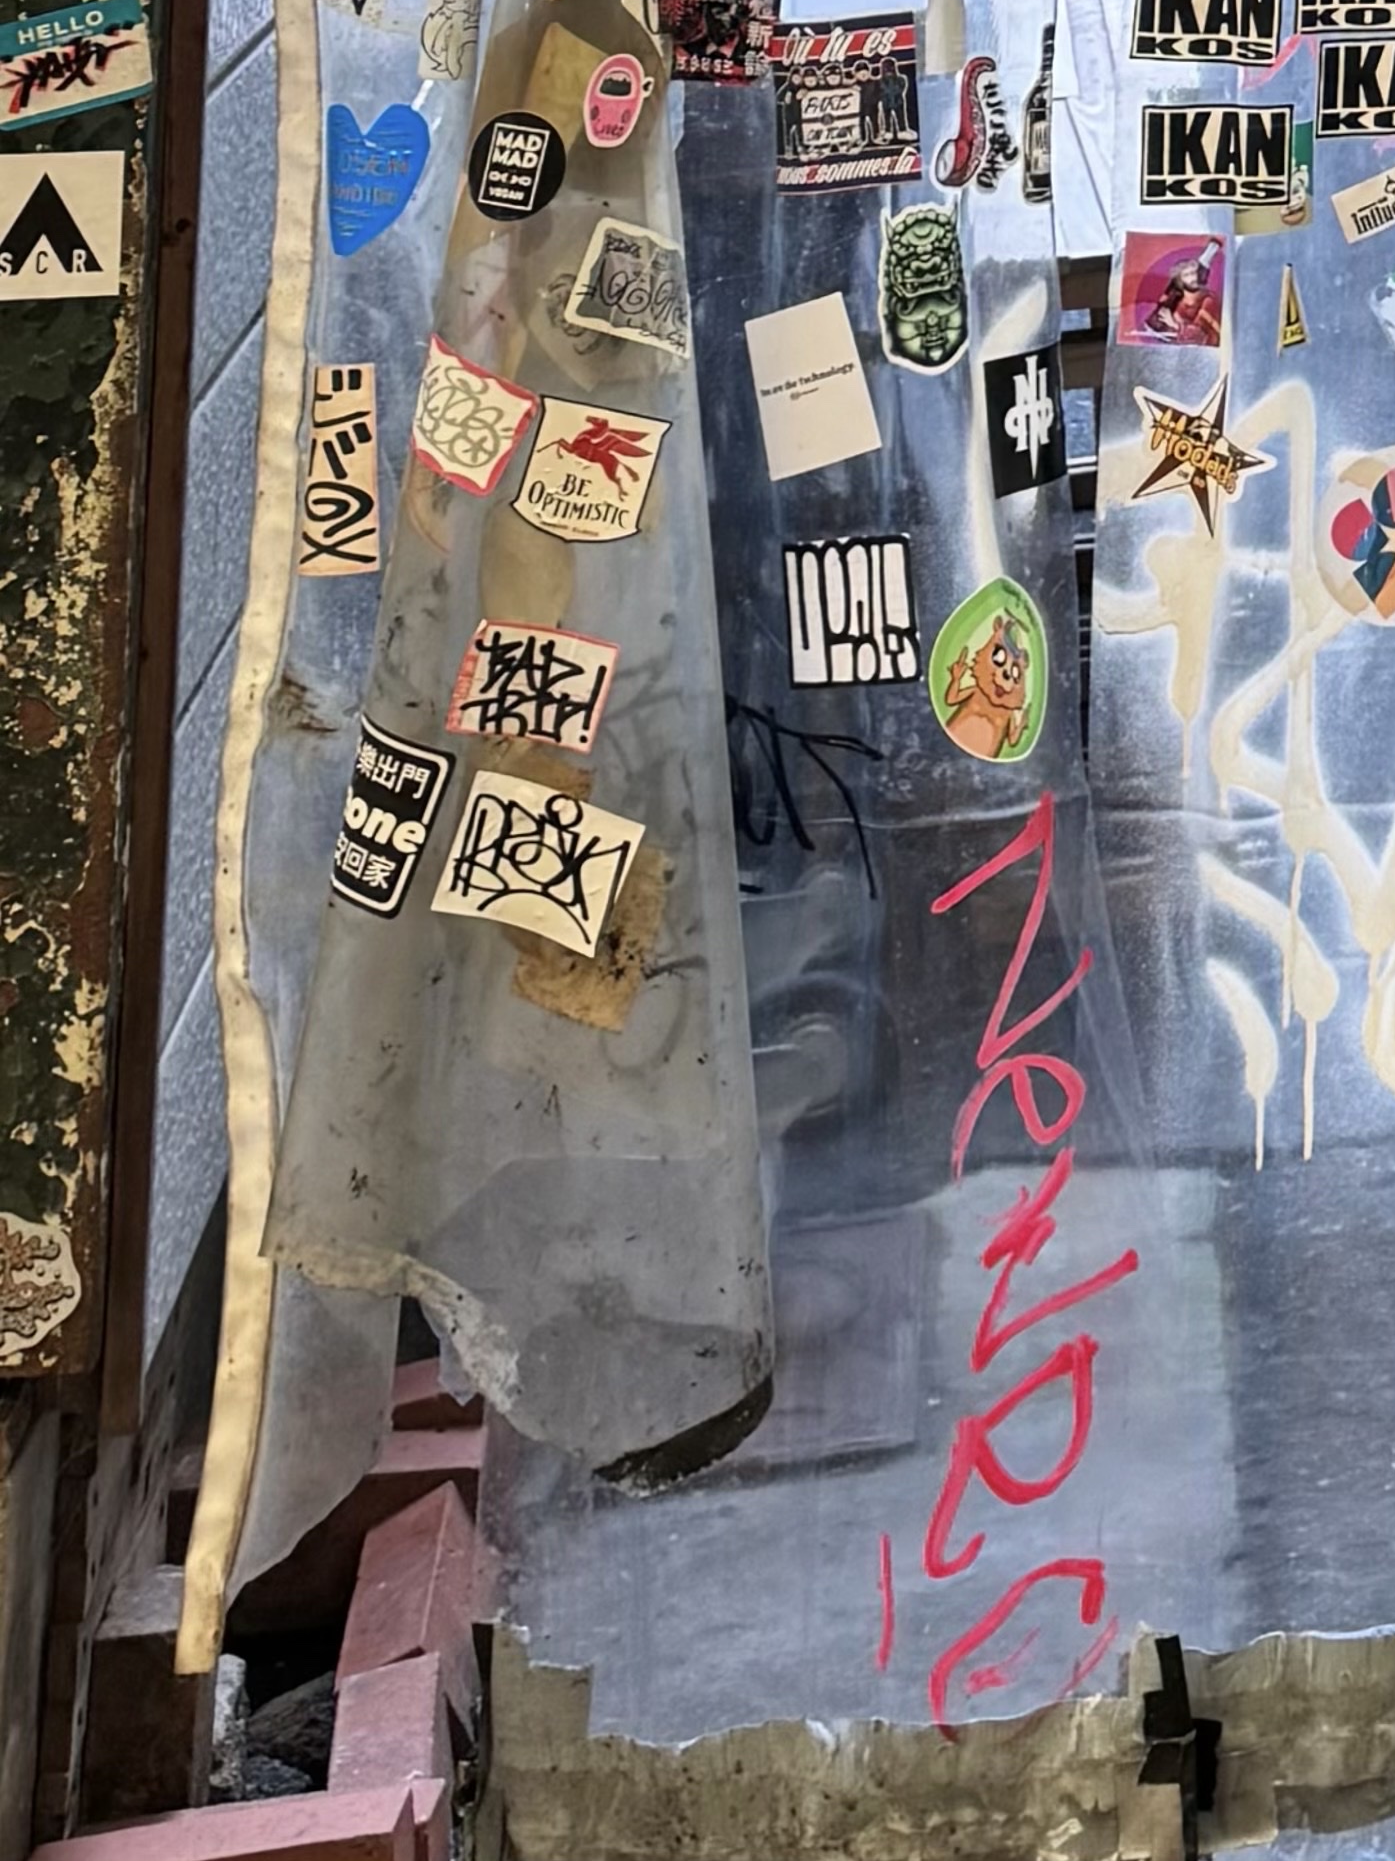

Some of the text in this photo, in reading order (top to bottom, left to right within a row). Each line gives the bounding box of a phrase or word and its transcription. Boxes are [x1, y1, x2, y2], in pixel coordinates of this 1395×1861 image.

[17, 9, 106, 45] HELLO
[1134, 36, 1274, 63] KOS
[497, 131, 543, 152] MAD
[1145, 110, 1288, 180] IKAN
[492, 148, 540, 171] MAD
[488, 186, 525, 201] VEGAN
[1145, 177, 1289, 204] KOS
[562, 473, 593, 498] BE
[360, 743, 432, 800] 樂出門
